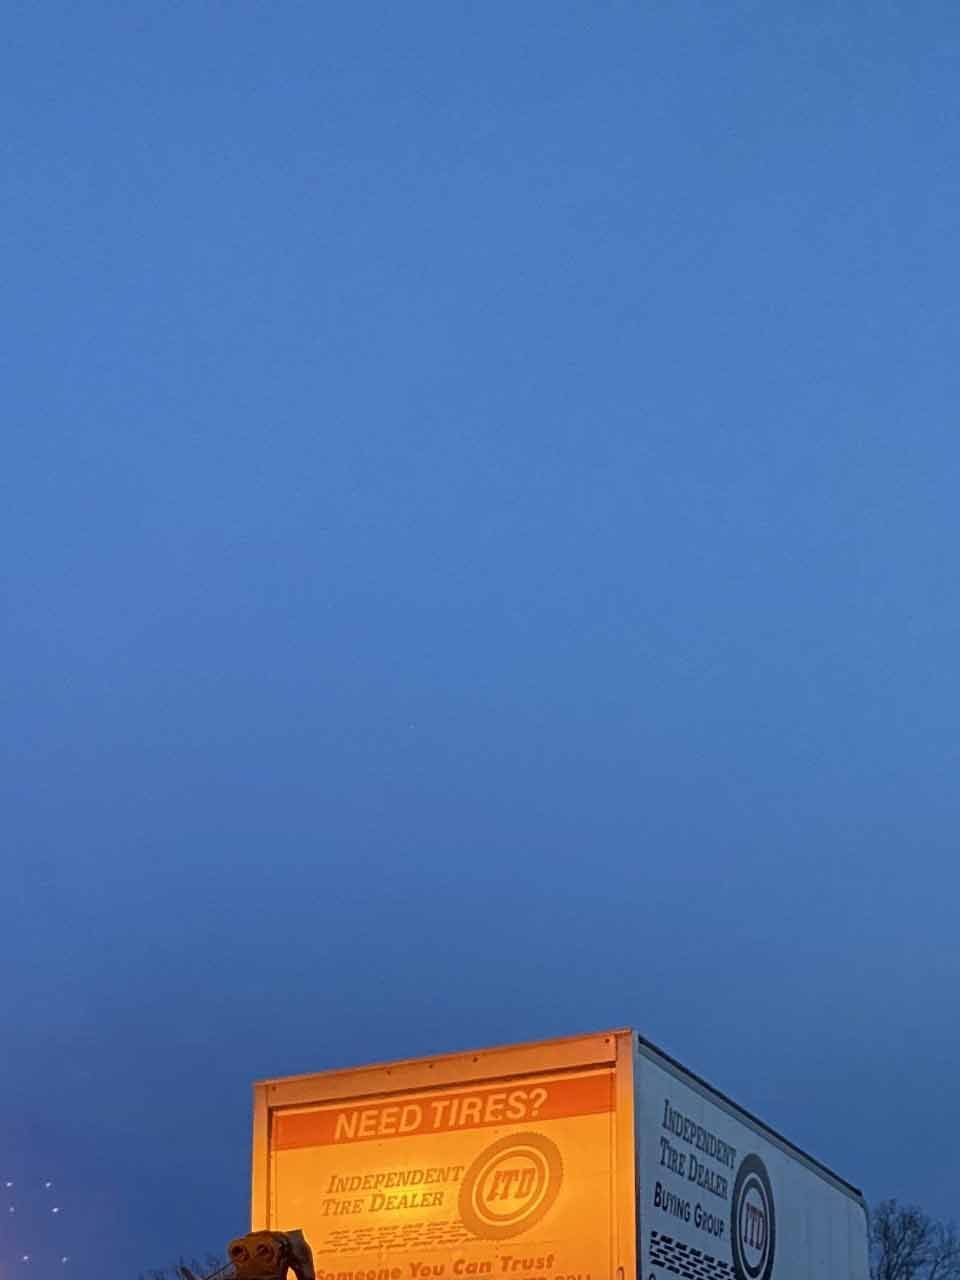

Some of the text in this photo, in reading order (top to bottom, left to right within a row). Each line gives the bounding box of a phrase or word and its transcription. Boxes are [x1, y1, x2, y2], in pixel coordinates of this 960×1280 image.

[334, 1088, 548, 1140] NEED TIRES?
[662, 1099, 736, 1169] INDEPENDENT
[326, 1166, 466, 1195] INDEPENDENT
[487, 1167, 536, 1202] ITD
[688, 1154, 728, 1200] DEALER
[321, 1191, 444, 1217] TIRE DEALER
[744, 1201, 767, 1250] ITD
[409, 1262, 445, 1278] You
[453, 1259, 492, 1275] Can
[501, 1254, 554, 1273] Trust
